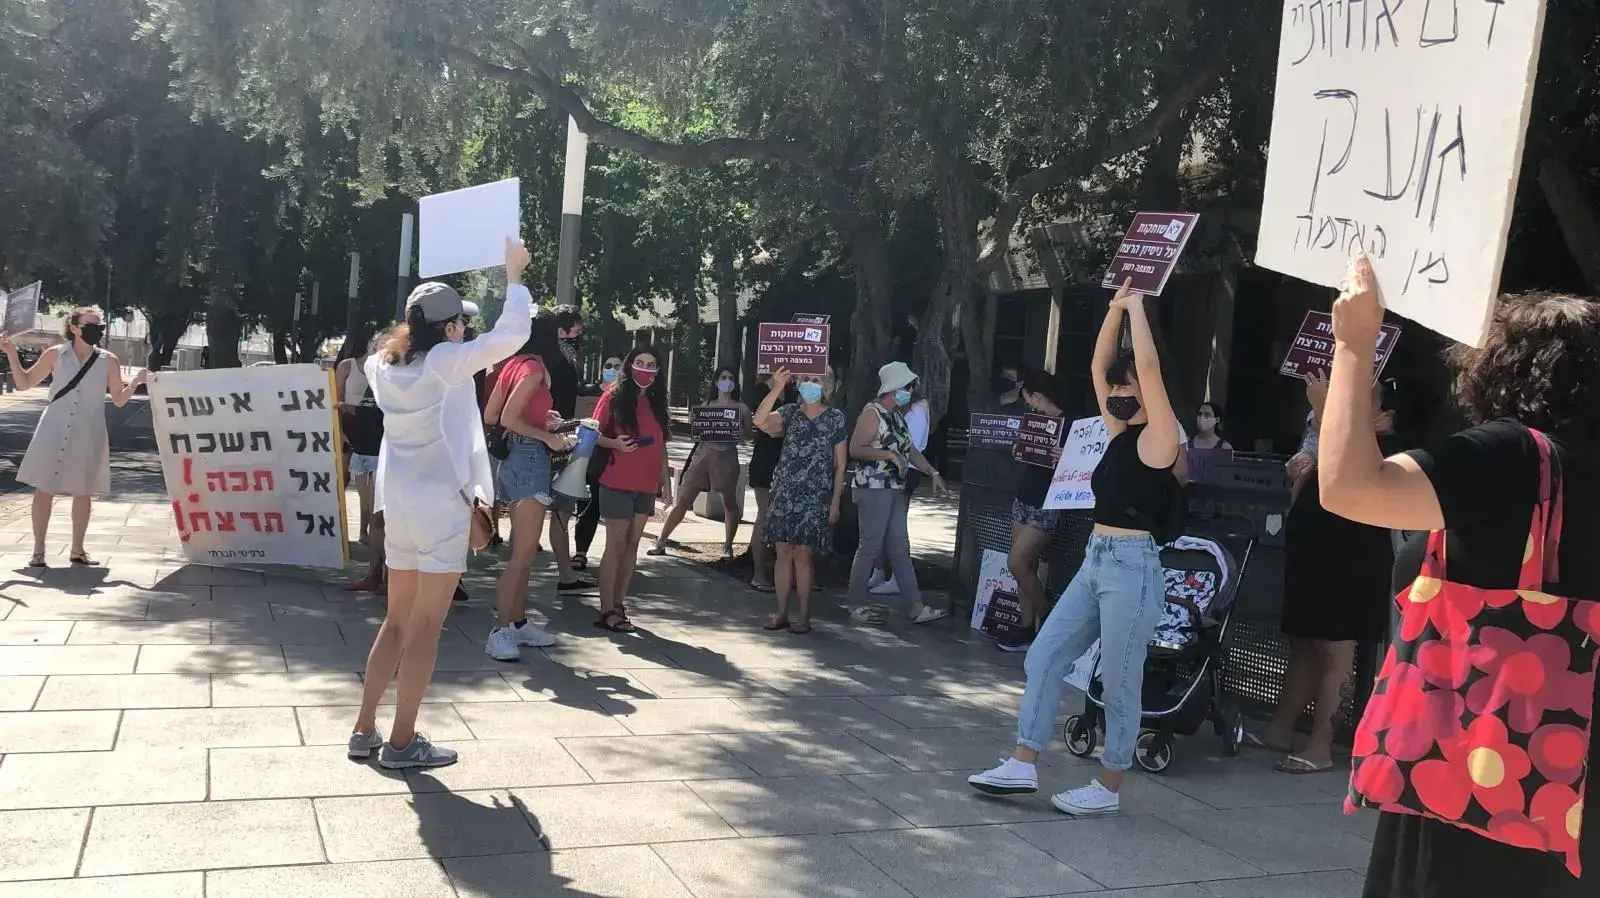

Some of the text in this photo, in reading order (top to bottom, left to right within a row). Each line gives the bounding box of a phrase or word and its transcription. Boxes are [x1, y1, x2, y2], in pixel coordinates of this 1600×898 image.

[1137, 223, 1168, 235] שותקות
[1120, 243, 1177, 258] על ניסיון הרצח
[1402, 248, 1449, 296] מן
[770, 330, 804, 339] שותקות
[760, 344, 826, 353] על ניסיון הרצח
[1296, 337, 1327, 350] הרצח
[1306, 355, 1326, 366] רמון
[165, 388, 327, 418] אני אישה
[980, 418, 1007, 426] שותקות
[170, 430, 330, 454] אל תשכח
[1049, 437, 1058, 446] על
[289, 468, 331, 493] אל
[296, 511, 336, 537] אל
